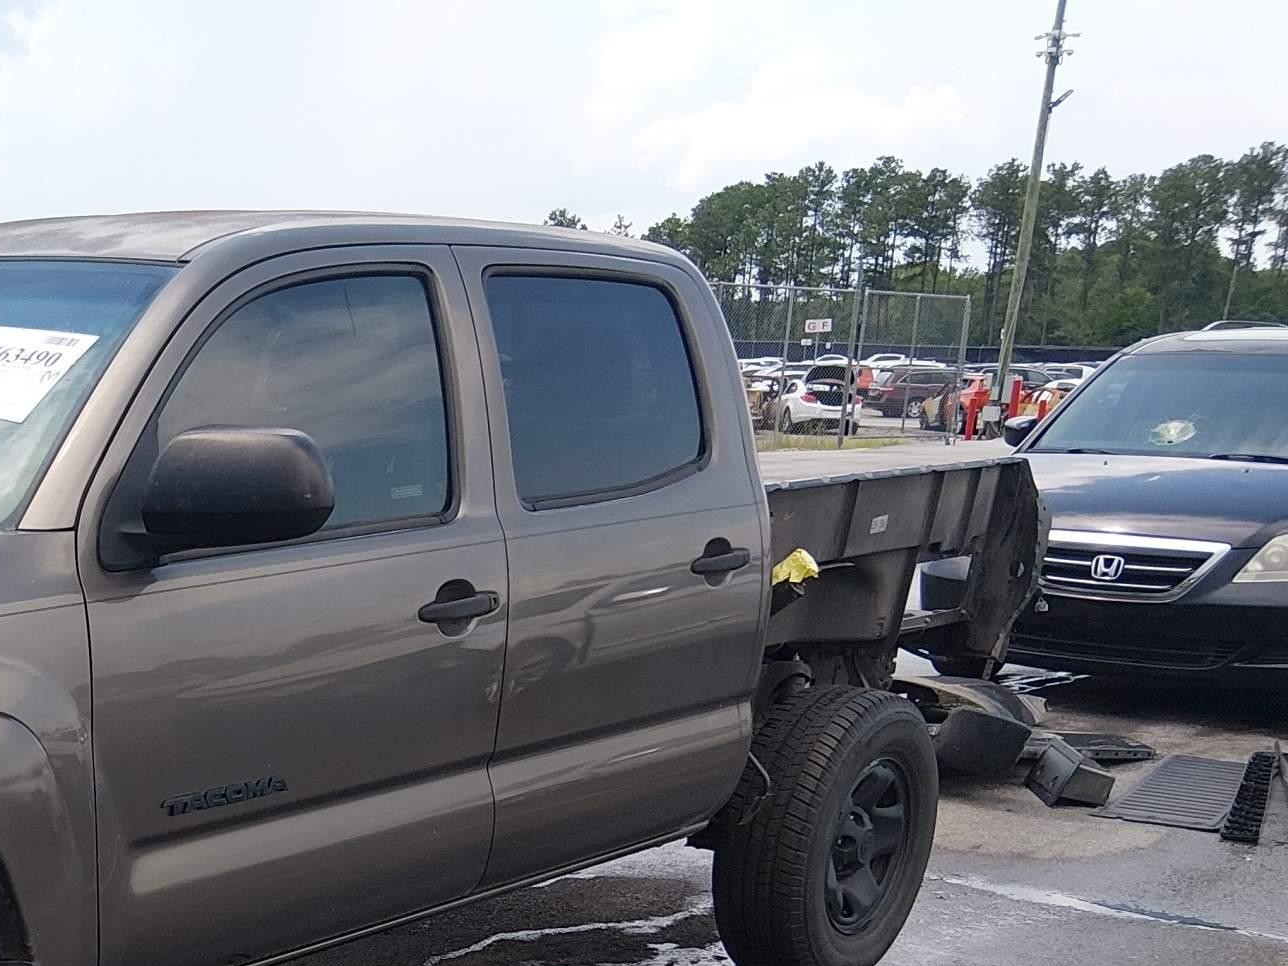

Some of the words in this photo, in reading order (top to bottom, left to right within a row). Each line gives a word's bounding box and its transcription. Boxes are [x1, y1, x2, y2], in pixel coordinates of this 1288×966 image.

[807, 322, 816, 331] G
[822, 321, 829, 330] F
[160, 775, 289, 816] TACOMA
